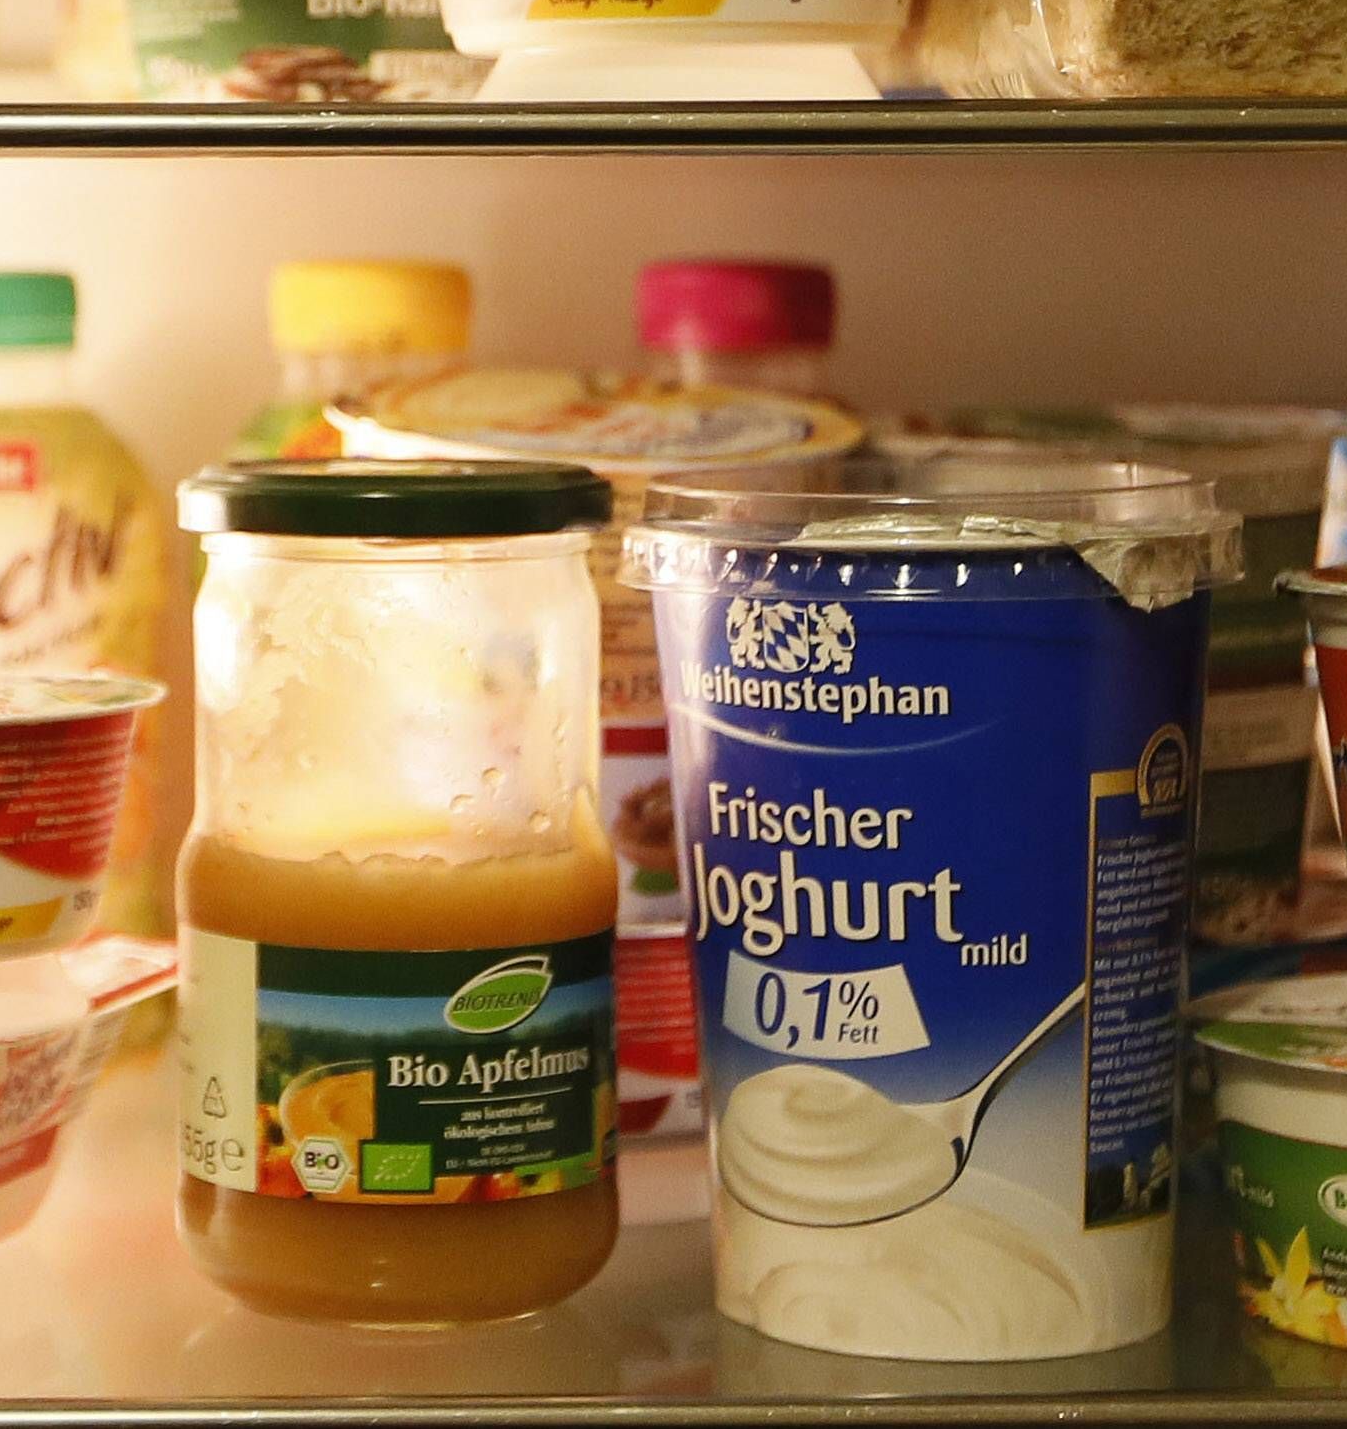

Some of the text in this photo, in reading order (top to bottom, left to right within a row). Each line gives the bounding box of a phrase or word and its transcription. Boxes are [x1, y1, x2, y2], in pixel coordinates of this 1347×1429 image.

[681, 658, 950, 724] Weihenstephan
[707, 781, 913, 851] Frischer
[694, 842, 964, 957] Joghurt
[960, 933, 1029, 967] mild
[755, 971, 880, 1050] 0,1%
[838, 1022, 880, 1046] Fett
[387, 1045, 591, 1093] Bio Apfelmus
